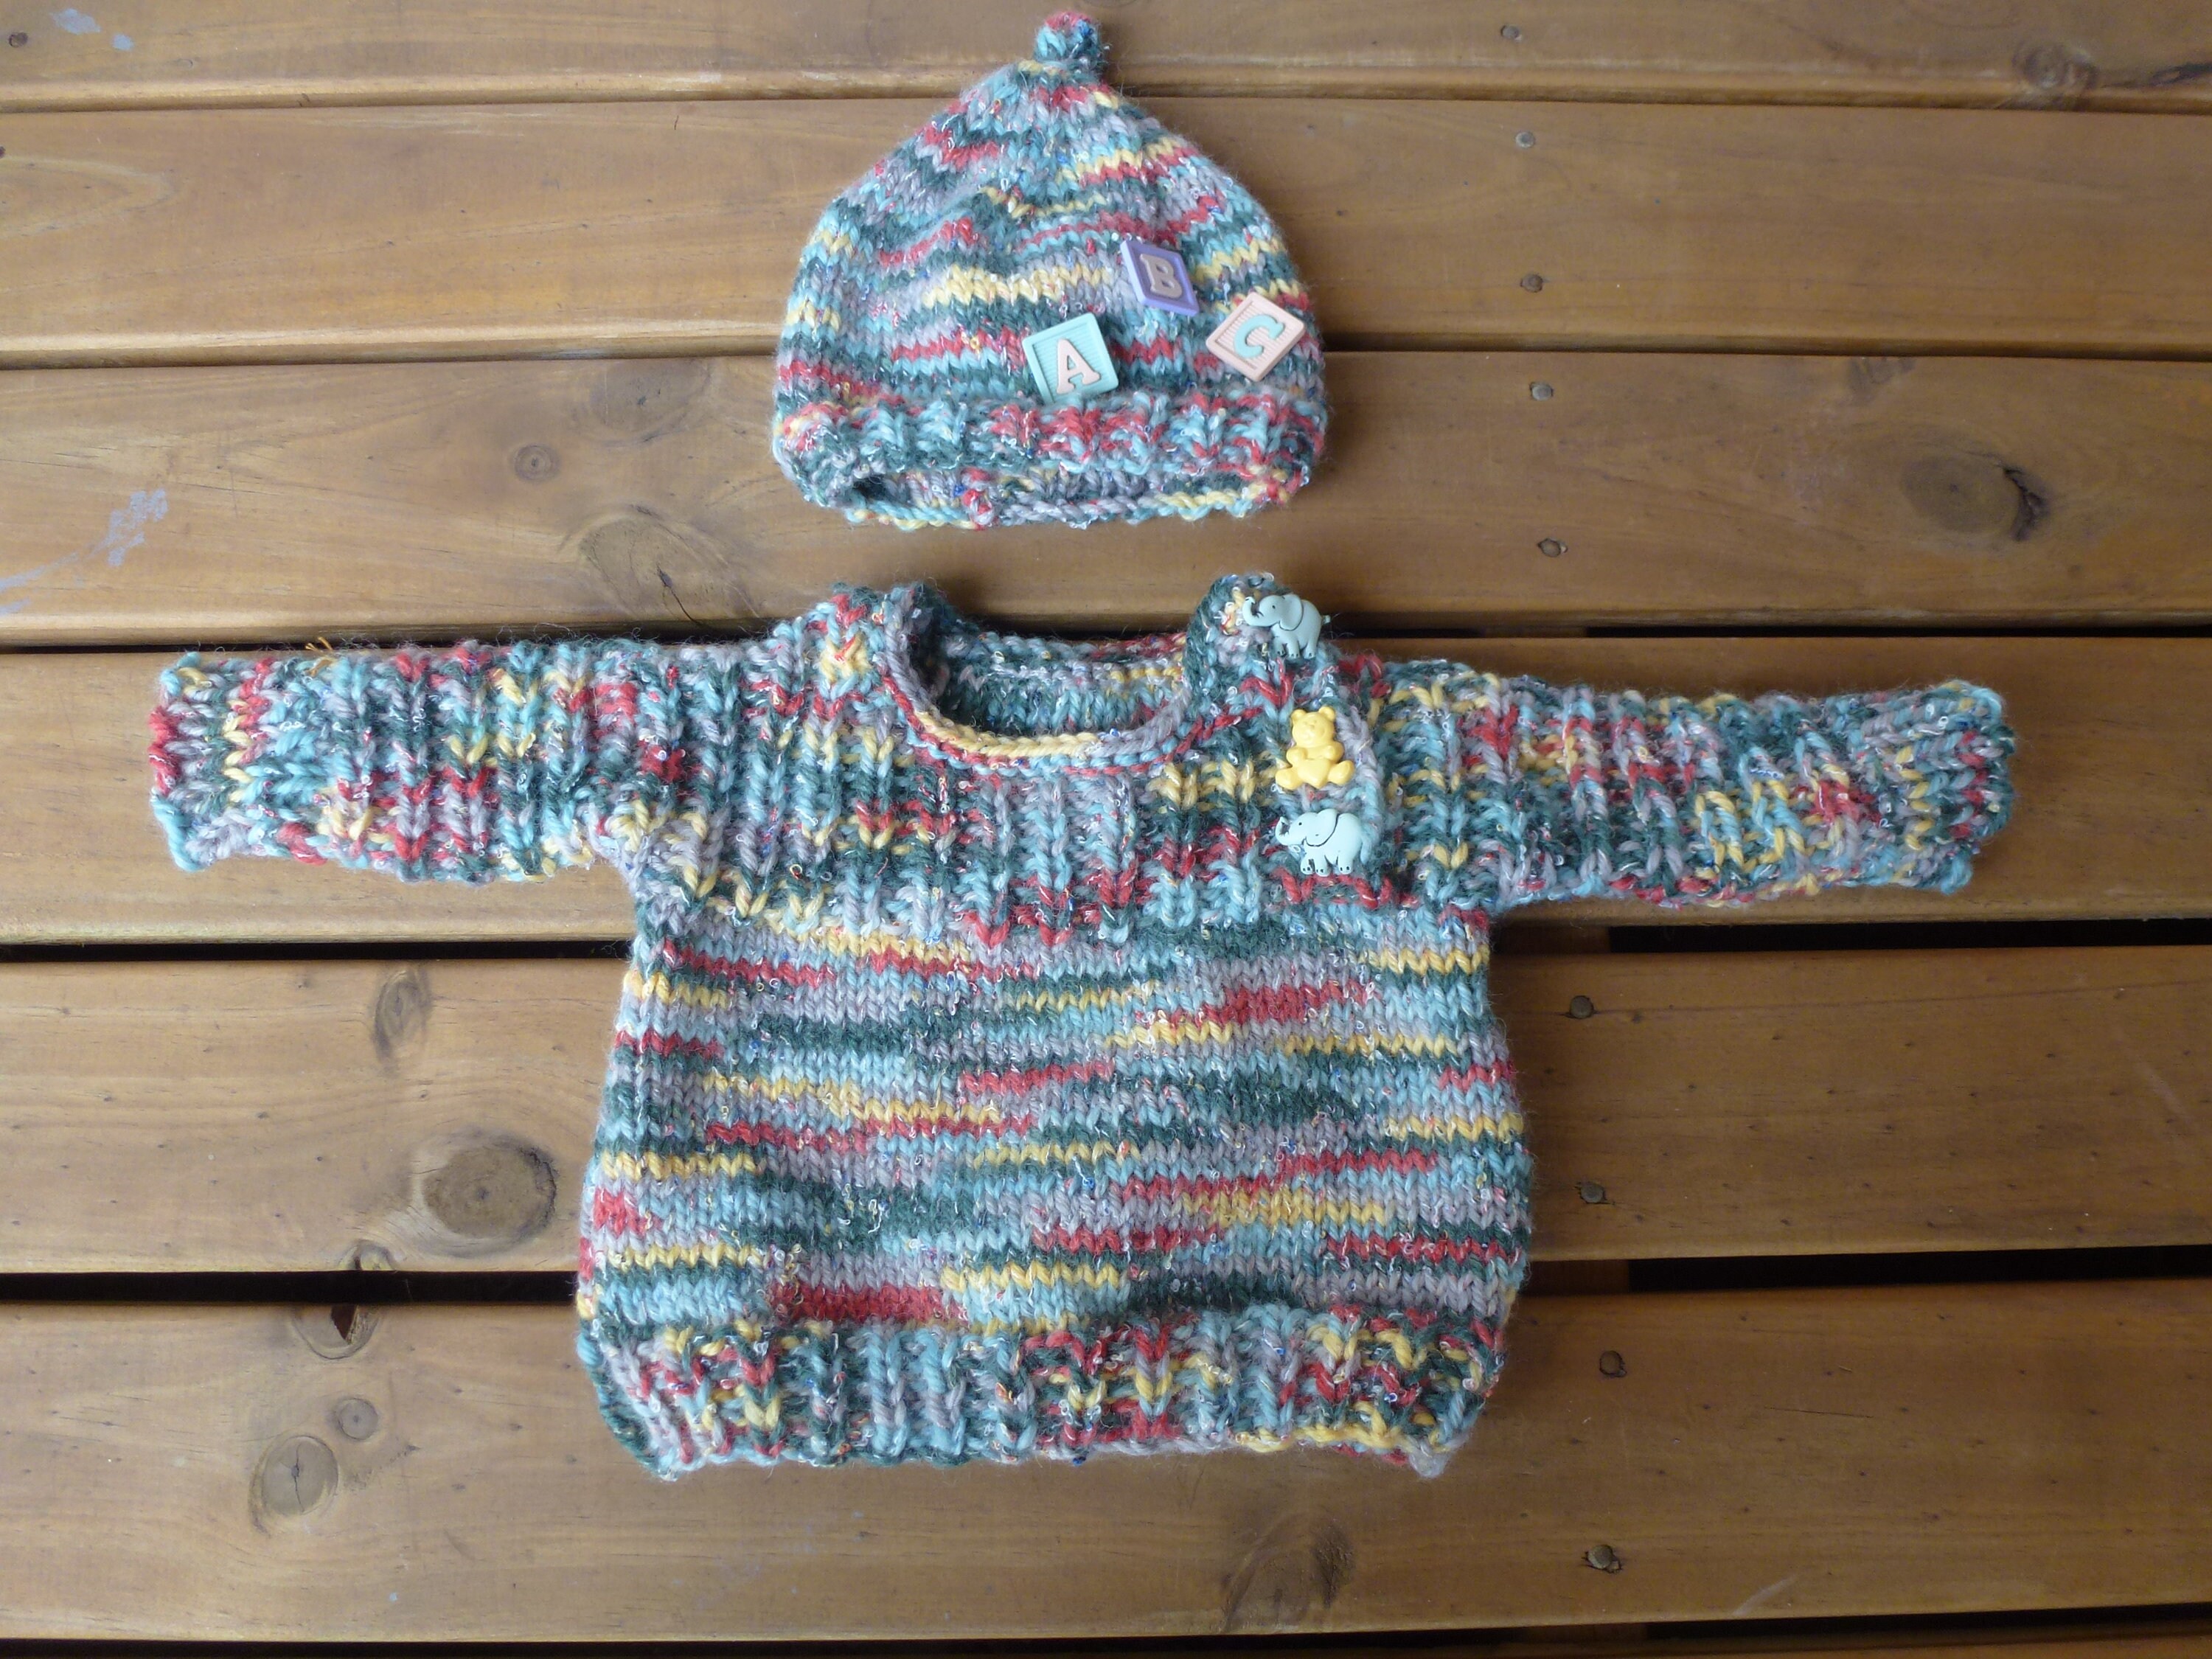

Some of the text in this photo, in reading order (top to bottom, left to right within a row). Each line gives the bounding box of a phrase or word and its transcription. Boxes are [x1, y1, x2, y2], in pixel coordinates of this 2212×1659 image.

[1140, 254, 1183, 297] B
[1235, 315, 1284, 358] C
[1057, 339, 1101, 394] A
